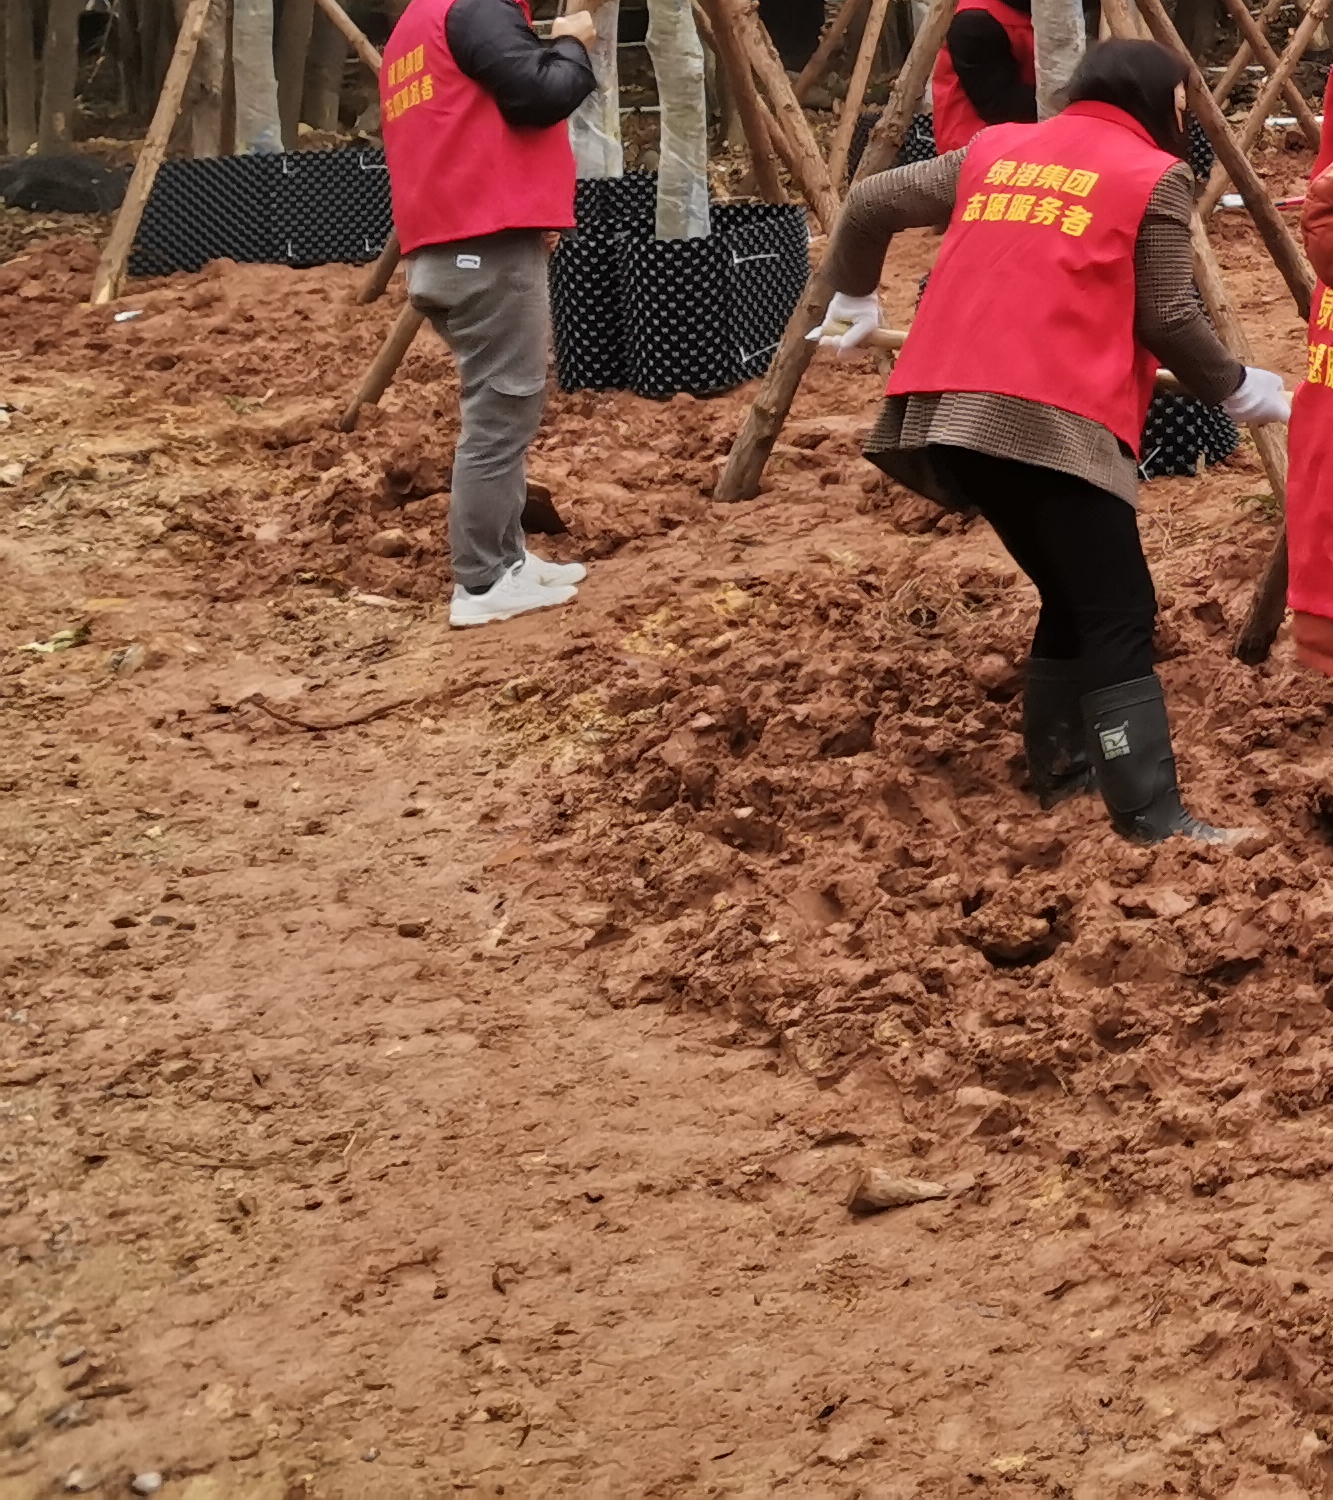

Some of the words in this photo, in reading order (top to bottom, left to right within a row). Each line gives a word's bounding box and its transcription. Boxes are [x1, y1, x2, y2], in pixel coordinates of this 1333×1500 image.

[984, 159, 1100, 198] 绿港集团
[961, 192, 1093, 237] 志愿服务者
